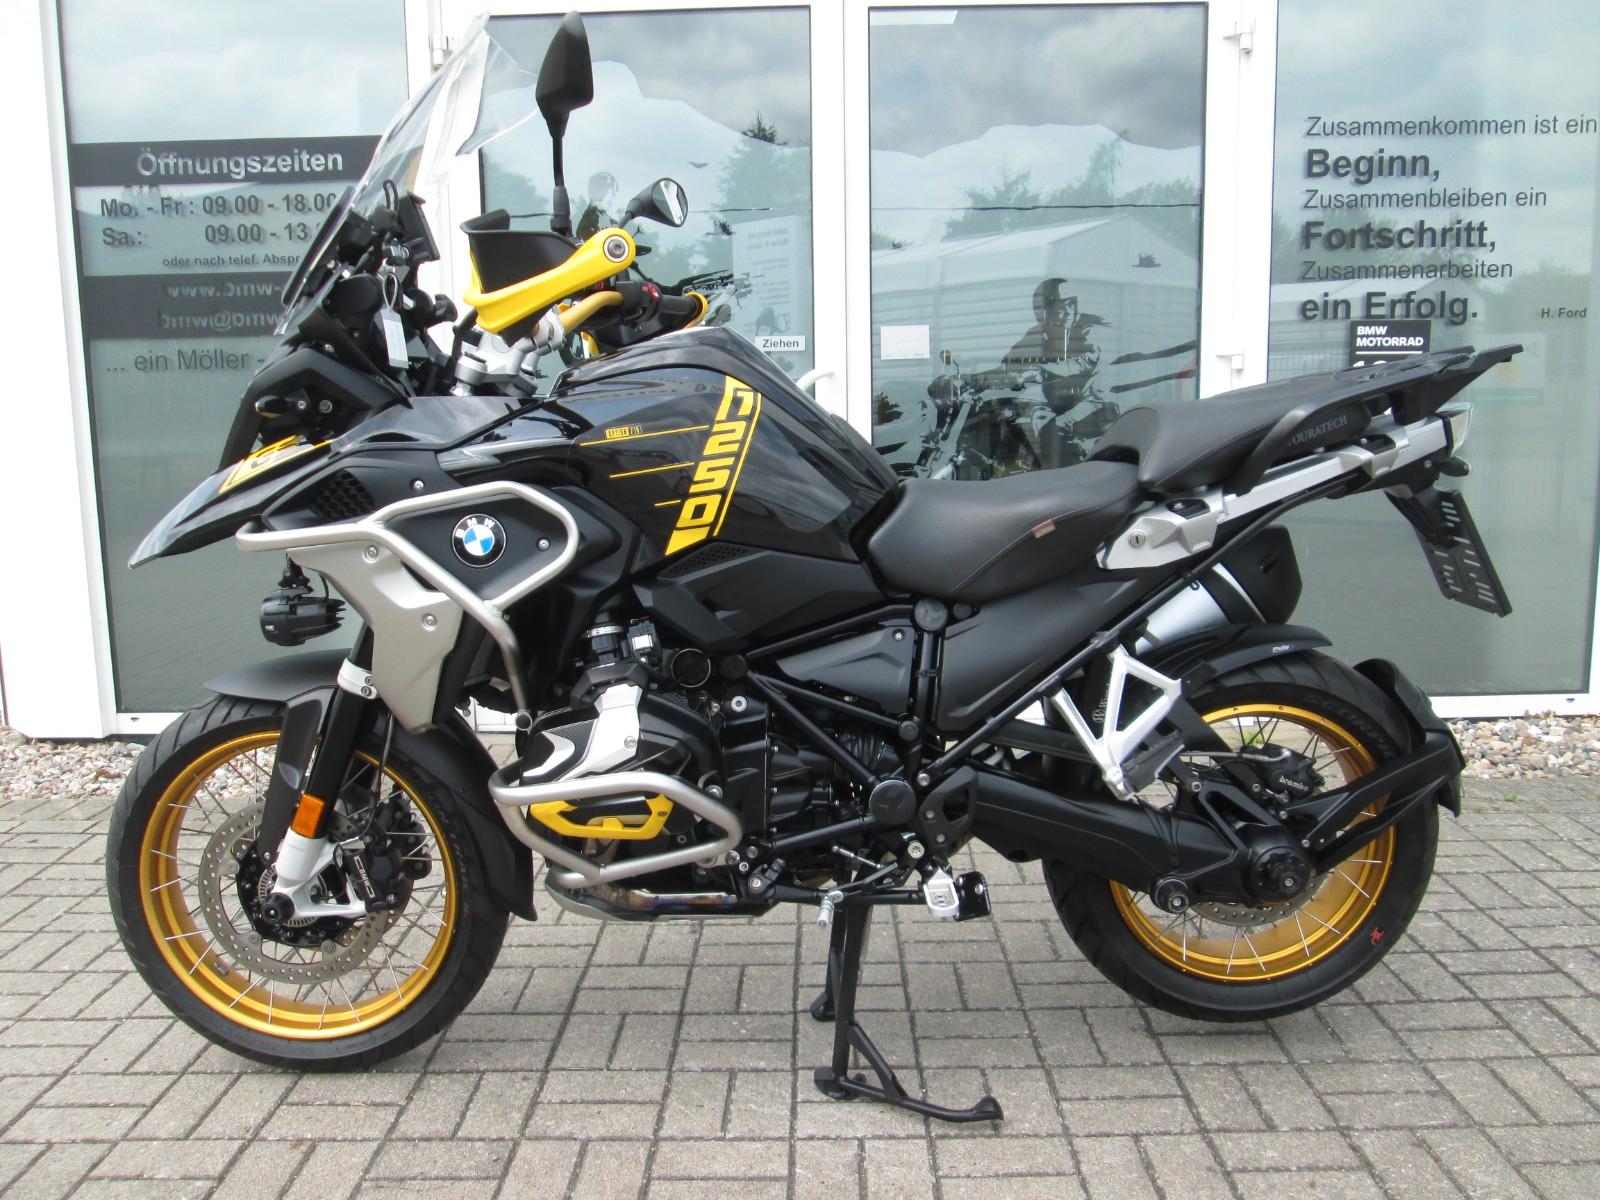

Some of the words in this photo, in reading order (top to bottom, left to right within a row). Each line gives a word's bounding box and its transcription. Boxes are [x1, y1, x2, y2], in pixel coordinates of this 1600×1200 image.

[1306, 115, 1526, 137] Zusammenkommen
[1534, 114, 1558, 134] ist
[1566, 114, 1597, 133] ein
[136, 147, 343, 180] Öffnungszeiten
[1306, 148, 1440, 185] Beginn,
[100, 198, 139, 217] Mo.
[202, 195, 259, 215] 09.00
[1303, 188, 1507, 209] Zusammenbleiben
[1515, 186, 1547, 206] ein
[205, 223, 261, 243] 09.00
[1304, 220, 1496, 252] Fortschritt,
[162, 256, 190, 267] oder
[194, 255, 225, 266] nach
[229, 254, 260, 265] telef.
[1301, 259, 1513, 280] Zusammenarbeiten
[1301, 292, 1351, 320] ein
[1365, 291, 1478, 326] Erfolg.
[1541, 308, 1554, 319] H.
[1558, 307, 1587, 319] Ford
[1357, 326, 1388, 335] BMW
[762, 338, 799, 349] Ziehen
[1356, 337, 1424, 347] MOTORRAD
[134, 350, 168, 371] ein
[178, 349, 248, 370] Möller
[454, 517, 496, 538] BMW
